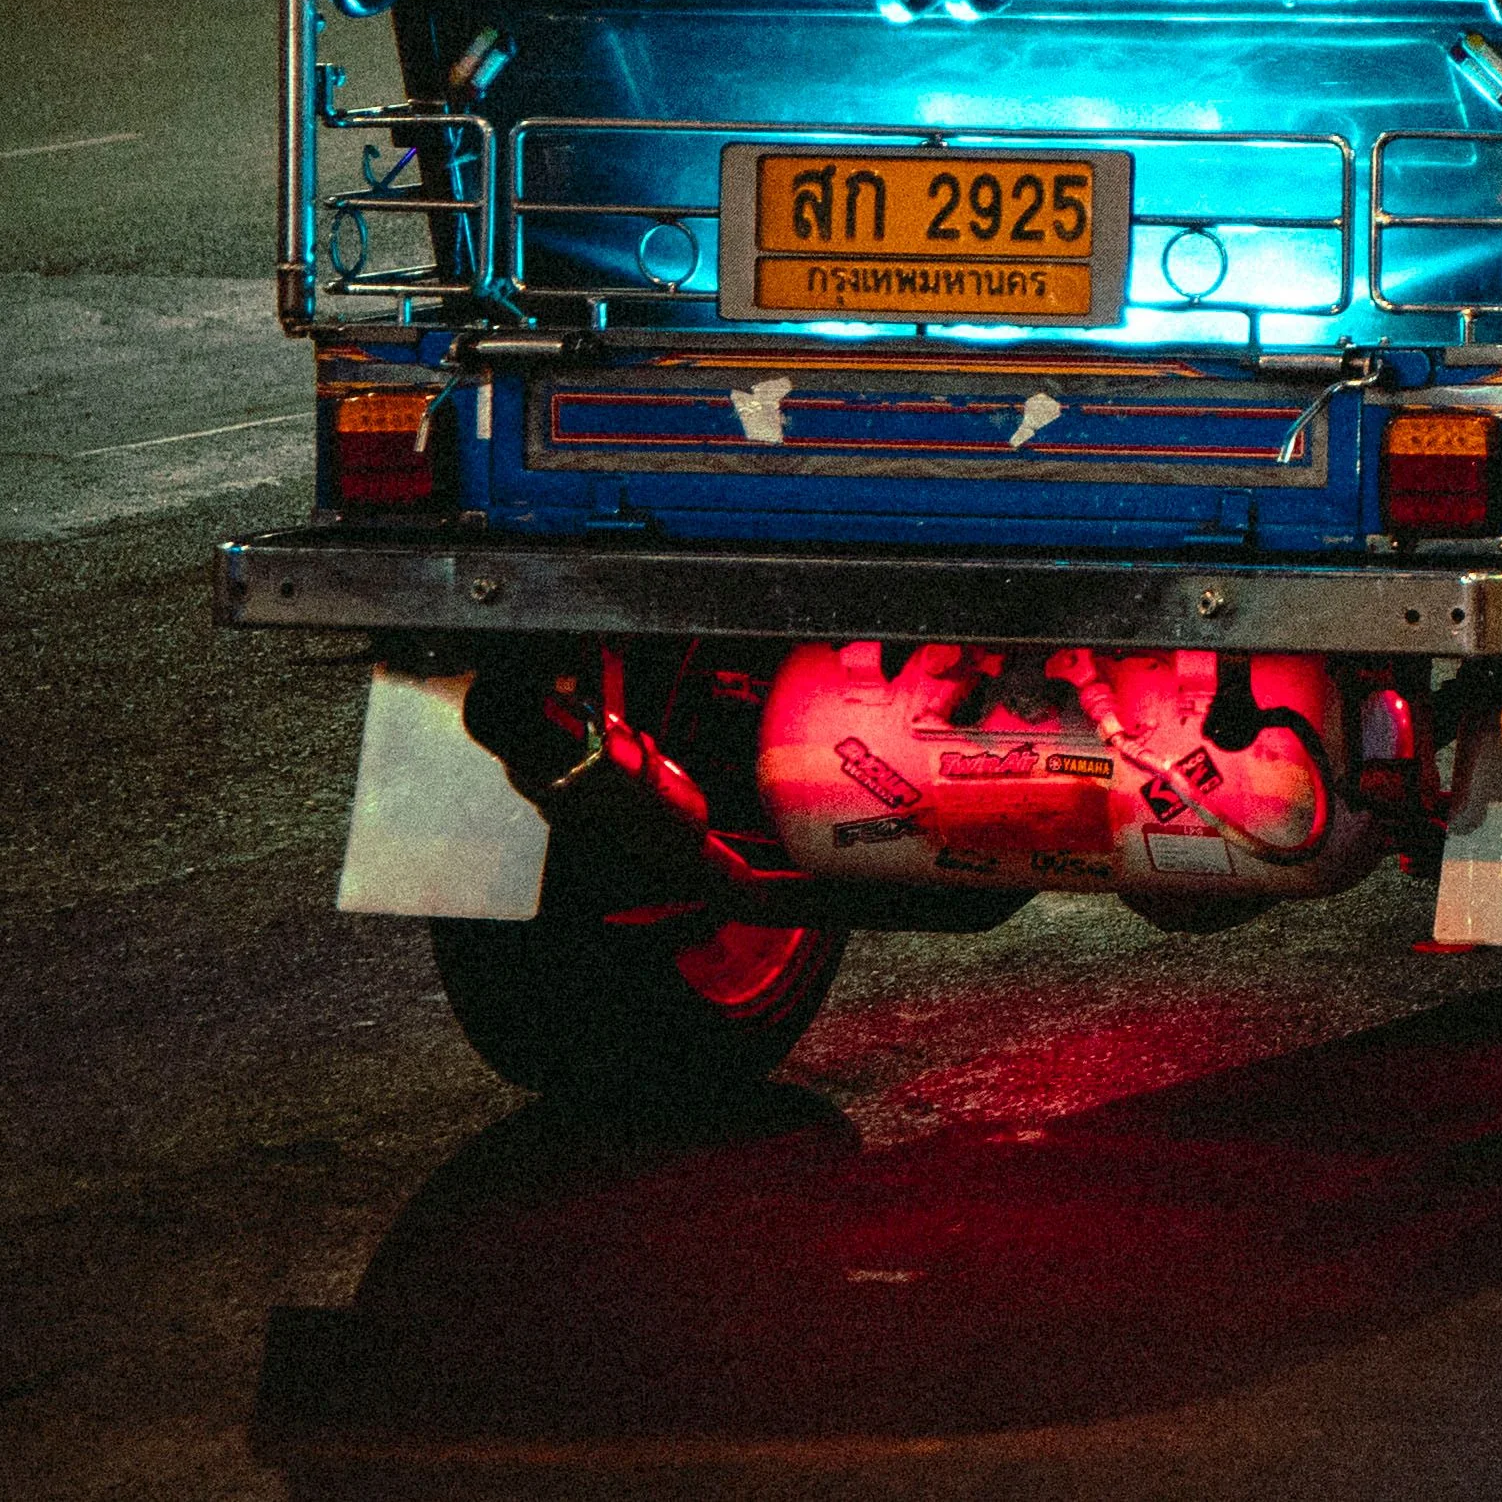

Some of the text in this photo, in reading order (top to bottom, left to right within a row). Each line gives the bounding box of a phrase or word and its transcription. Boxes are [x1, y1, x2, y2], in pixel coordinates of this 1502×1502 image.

[791, 164, 1090, 243] สก 2925
[806, 264, 1048, 306] กรุงเทพมหานคร
[1062, 758, 1110, 775] YAMAHA
